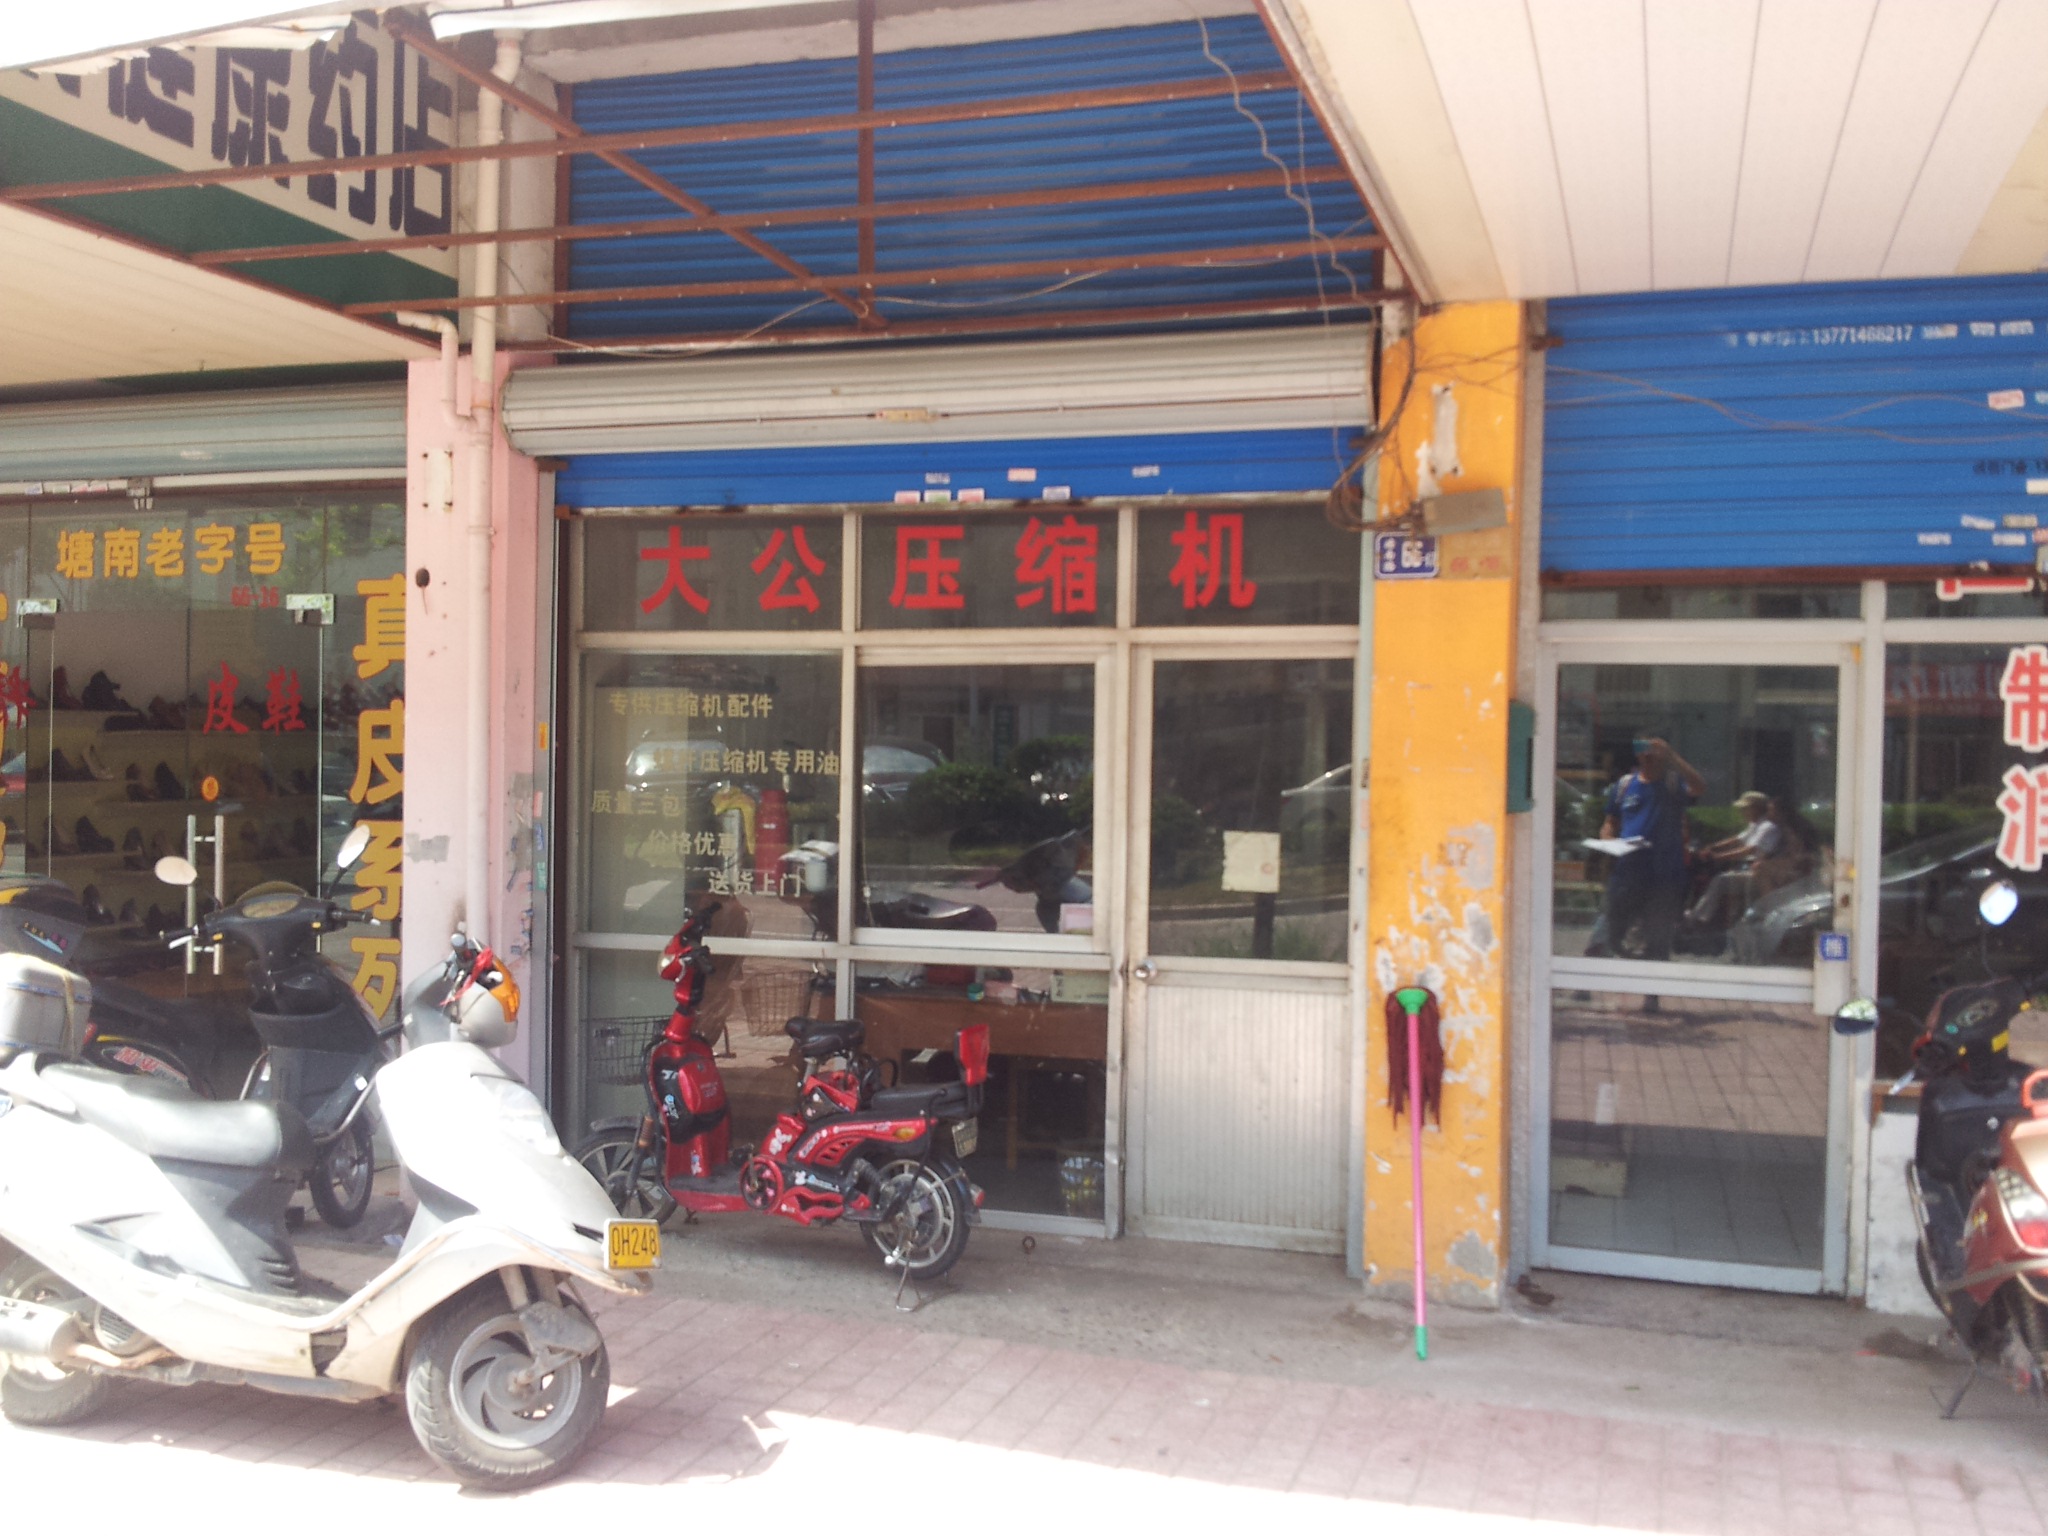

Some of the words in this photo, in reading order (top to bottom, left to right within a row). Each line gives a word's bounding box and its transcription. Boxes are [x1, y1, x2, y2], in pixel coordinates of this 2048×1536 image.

[56, 522, 286, 579] 塘南老字号
[639, 511, 1257, 615] 大公压缩机
[203, 660, 306, 736] 皮鞋
[609, 693, 773, 718] 专供压缩机配件
[592, 790, 683, 817] 质量三包
[650, 830, 738, 857] 价格优惠
[708, 871, 801, 898] 送货上门
